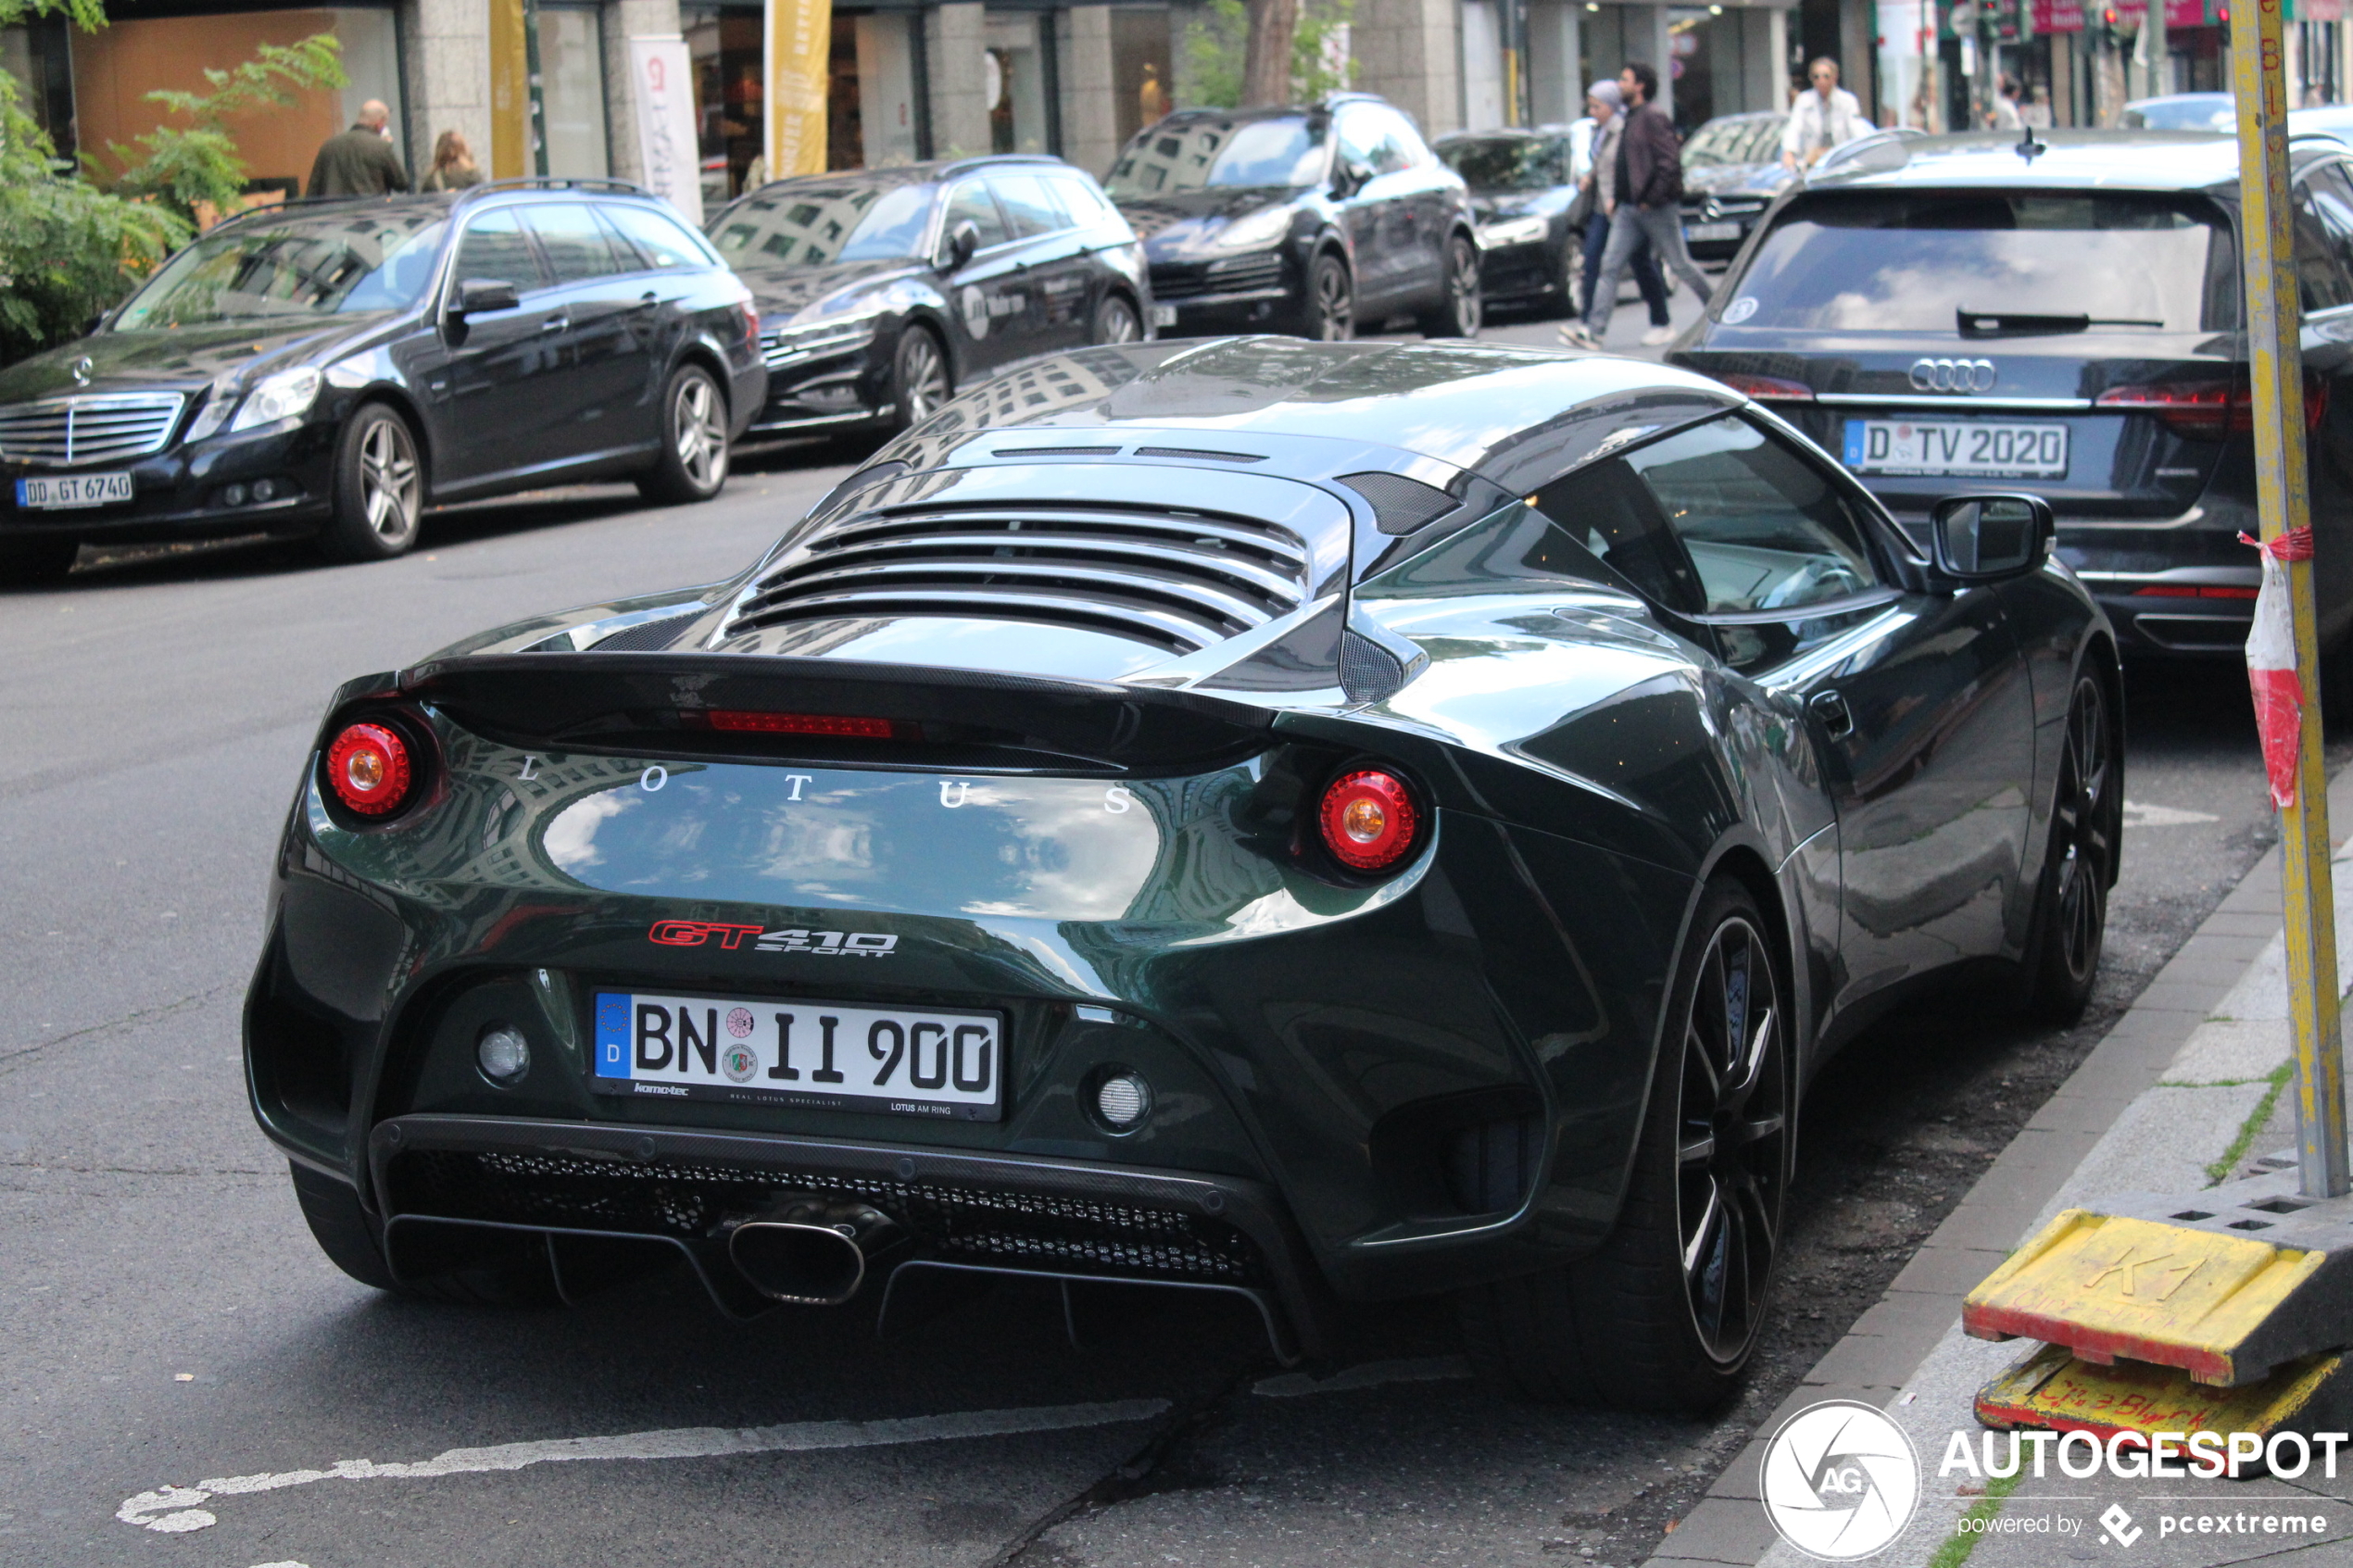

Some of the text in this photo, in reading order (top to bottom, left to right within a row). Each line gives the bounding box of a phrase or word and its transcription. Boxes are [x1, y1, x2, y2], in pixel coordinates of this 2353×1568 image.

[1868, 427, 1890, 460] D
[1917, 427, 1961, 462] TV
[1969, 430, 2061, 464] 2020
[28, 475, 130, 503] DD GT 6740
[517, 755, 1130, 815] LOTUS
[648, 920, 899, 949] GT 410
[754, 943, 896, 958] SPORT
[607, 1003, 992, 1093] D BN II 900
[757, 1095, 786, 1103] LOTUS
[789, 1098, 842, 1106] SPECIALIST
[890, 1102, 951, 1115] LOTUS AM RING
